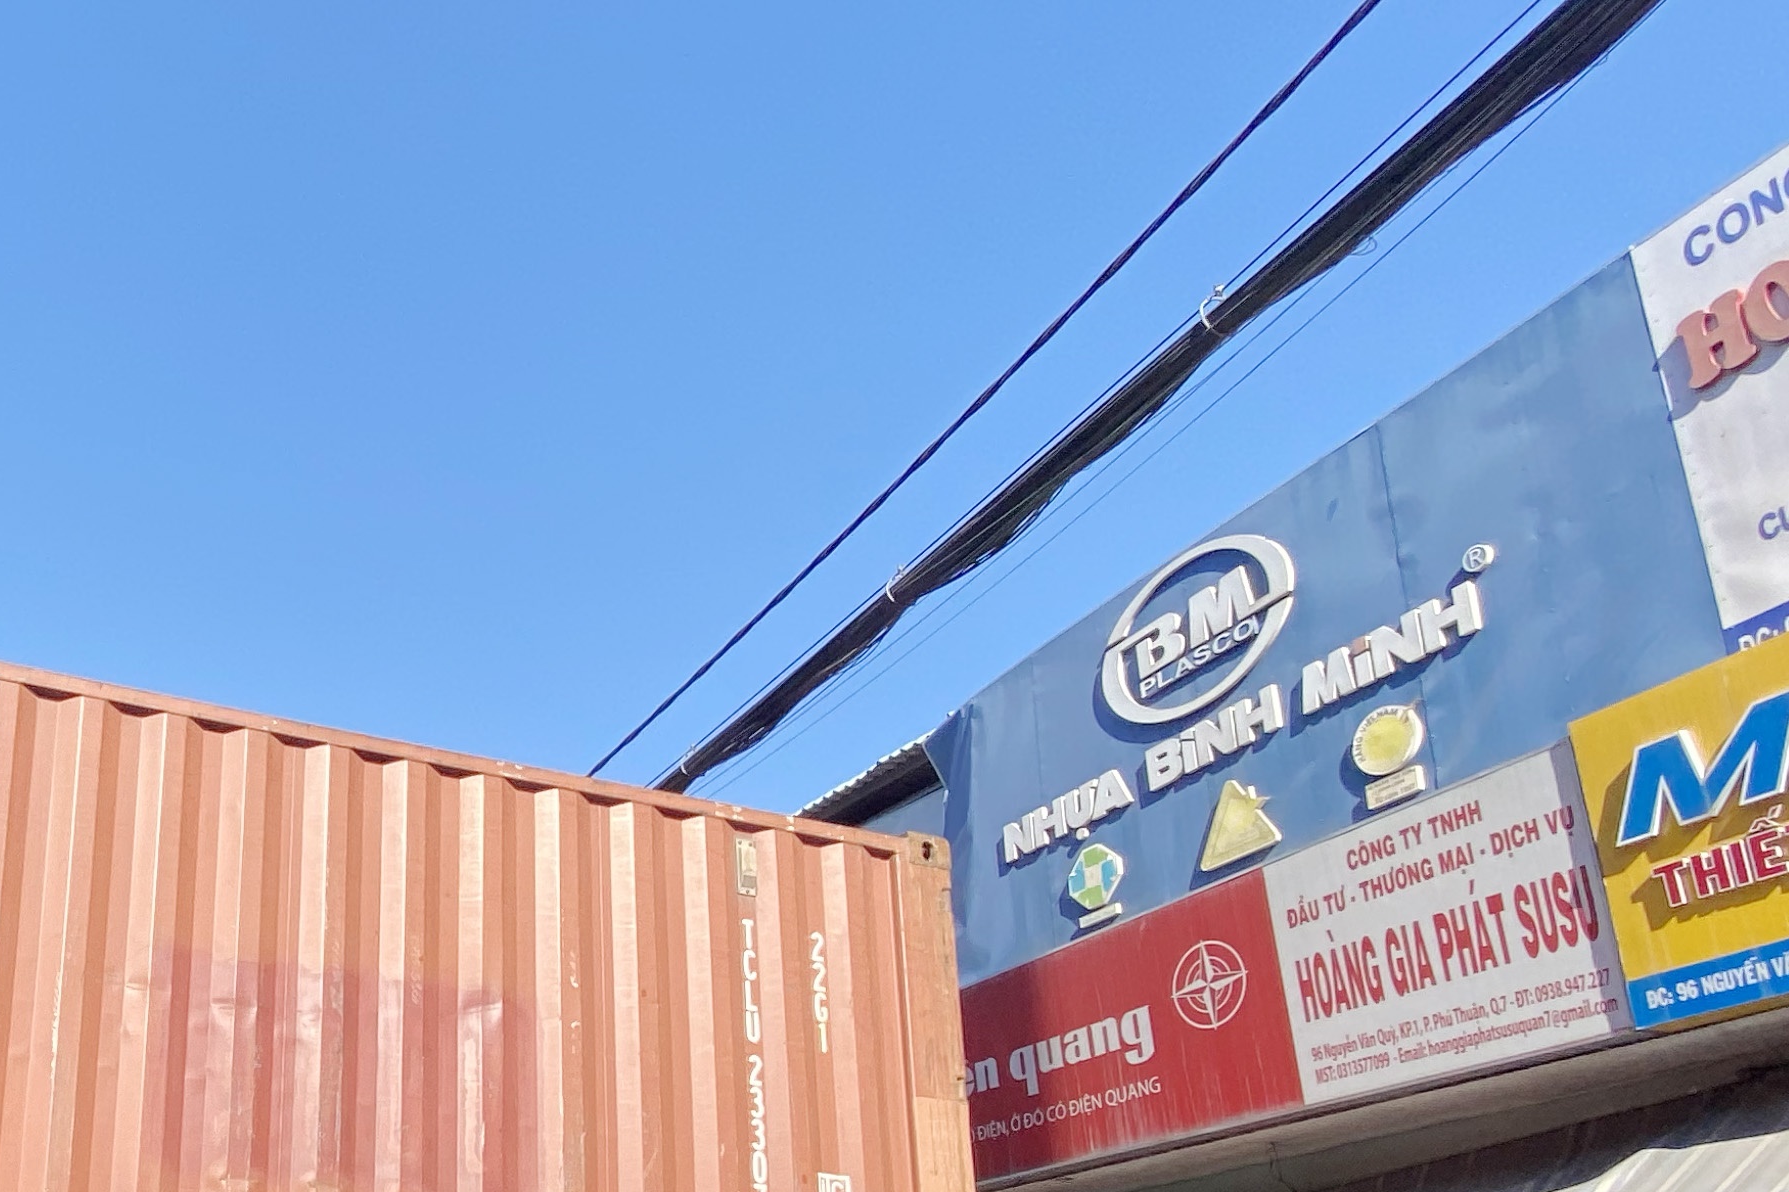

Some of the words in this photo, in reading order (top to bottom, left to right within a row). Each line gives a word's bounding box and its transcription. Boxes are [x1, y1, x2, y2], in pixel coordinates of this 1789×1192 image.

[1683, 165, 1789, 266] CON
[1134, 564, 1256, 680] BM
[1287, 894, 1319, 928] ĐẦU
[1323, 884, 1347, 916] TƯ
[1359, 858, 1434, 903] THƯƠNG
[1437, 843, 1475, 875] MẠI
[1489, 818, 1540, 858] DỊCH
[1544, 805, 1574, 836] VỤ
[1346, 834, 1396, 870] CÔNG
[1399, 821, 1422, 849] TY
[1427, 800, 1483, 836] TNHH
[741, 918, 761, 1043] TCLU
[809, 930, 829, 1054] 22G1
[1295, 929, 1385, 1023] HOÀNG
[1385, 920, 1437, 997] GIA
[1433, 878, 1511, 982] PHÁT
[1514, 864, 1599, 959] SUSU
[1675, 979, 1700, 1002] 96
[1769, 950, 1789, 977] V
[1009, 1004, 1156, 1097] quang
[1311, 1047, 1324, 1062] 96
[1490, 995, 1507, 1015] Q.7
[1535, 967, 1610, 1003] 0938.947.227
[1046, 1099, 1067, 1123] CÓ
[1069, 1093, 1103, 1117] ĐIỆN
[1105, 1076, 1162, 1107] QUANG
